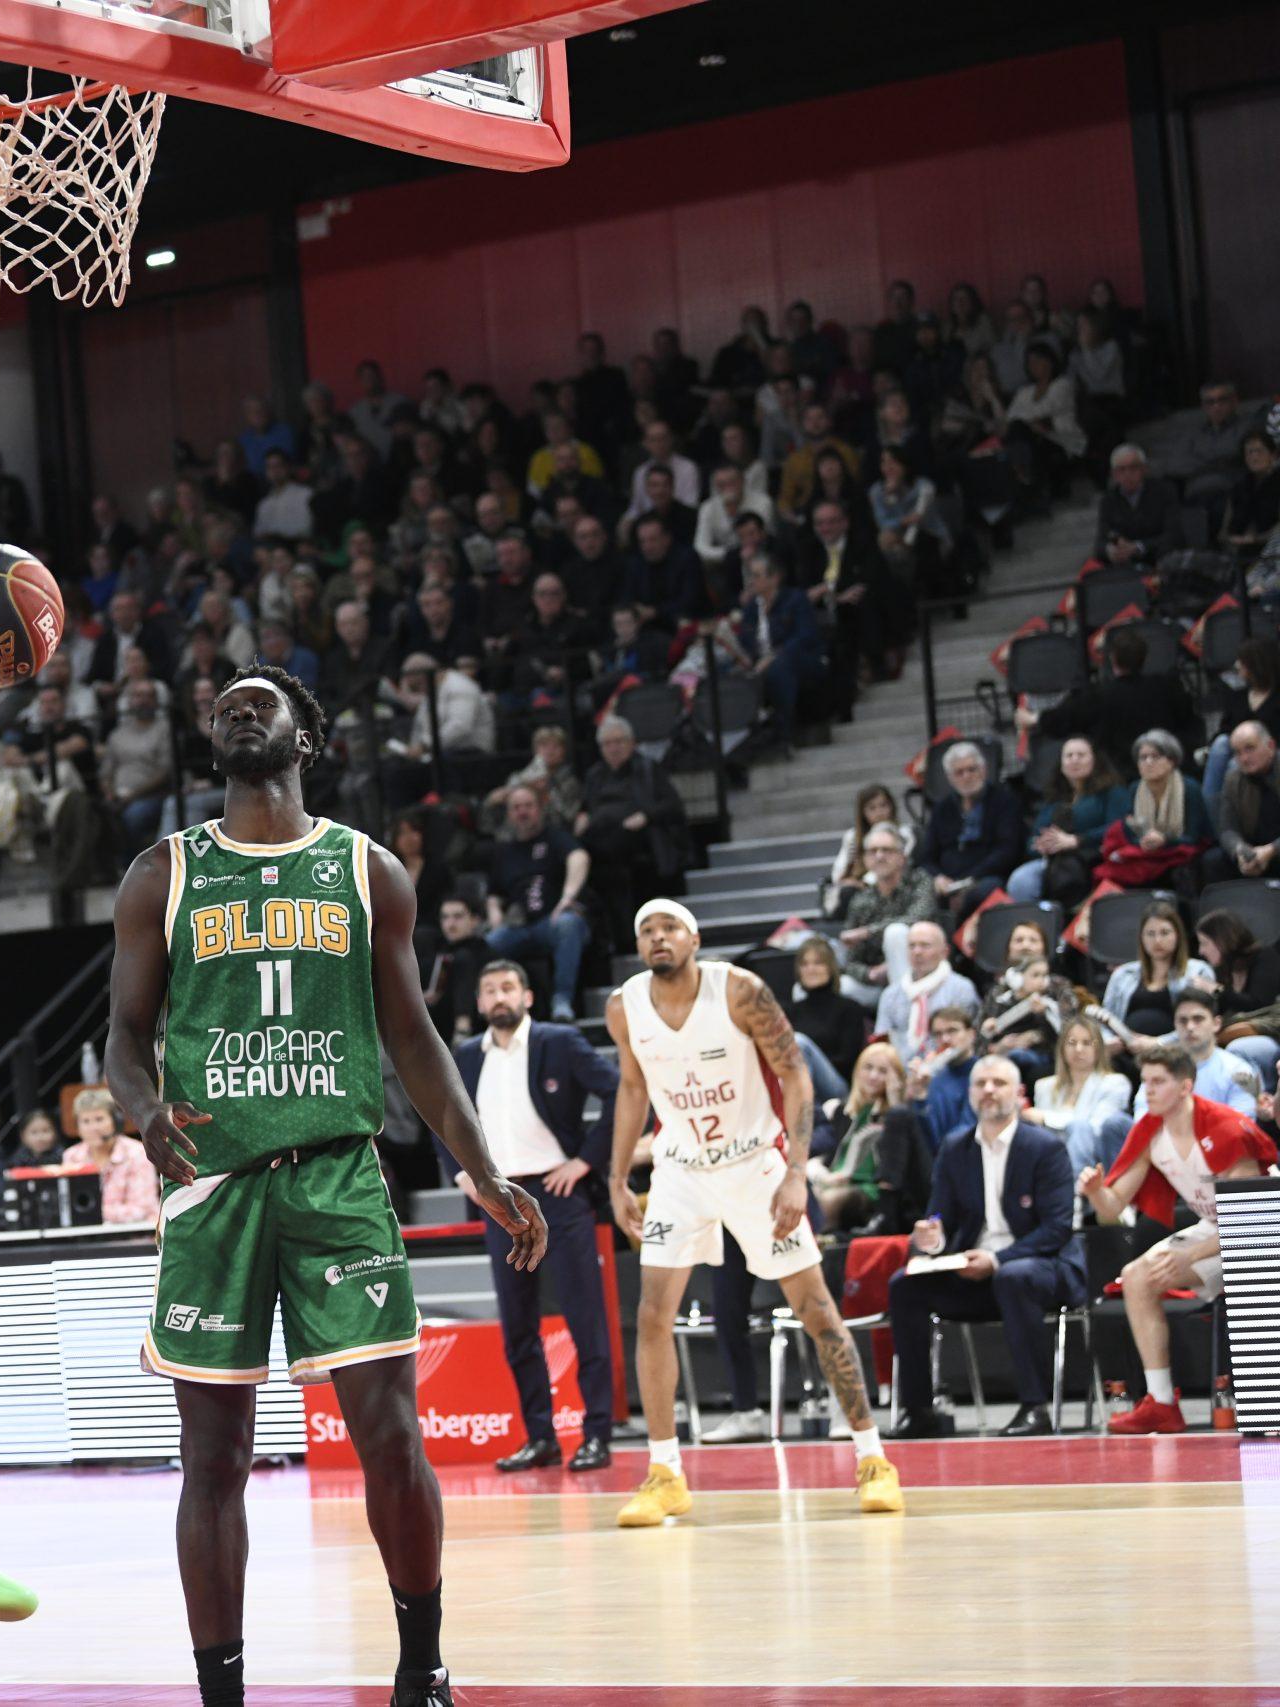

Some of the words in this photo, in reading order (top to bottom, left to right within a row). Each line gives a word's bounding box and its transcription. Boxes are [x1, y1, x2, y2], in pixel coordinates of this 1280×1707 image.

[191, 898, 351, 964] BLOIS
[256, 960, 293, 1016] 11
[206, 1064, 346, 1099] BEAUVAL
[688, 1115, 724, 1145] 12
[167, 1306, 198, 1329] isf
